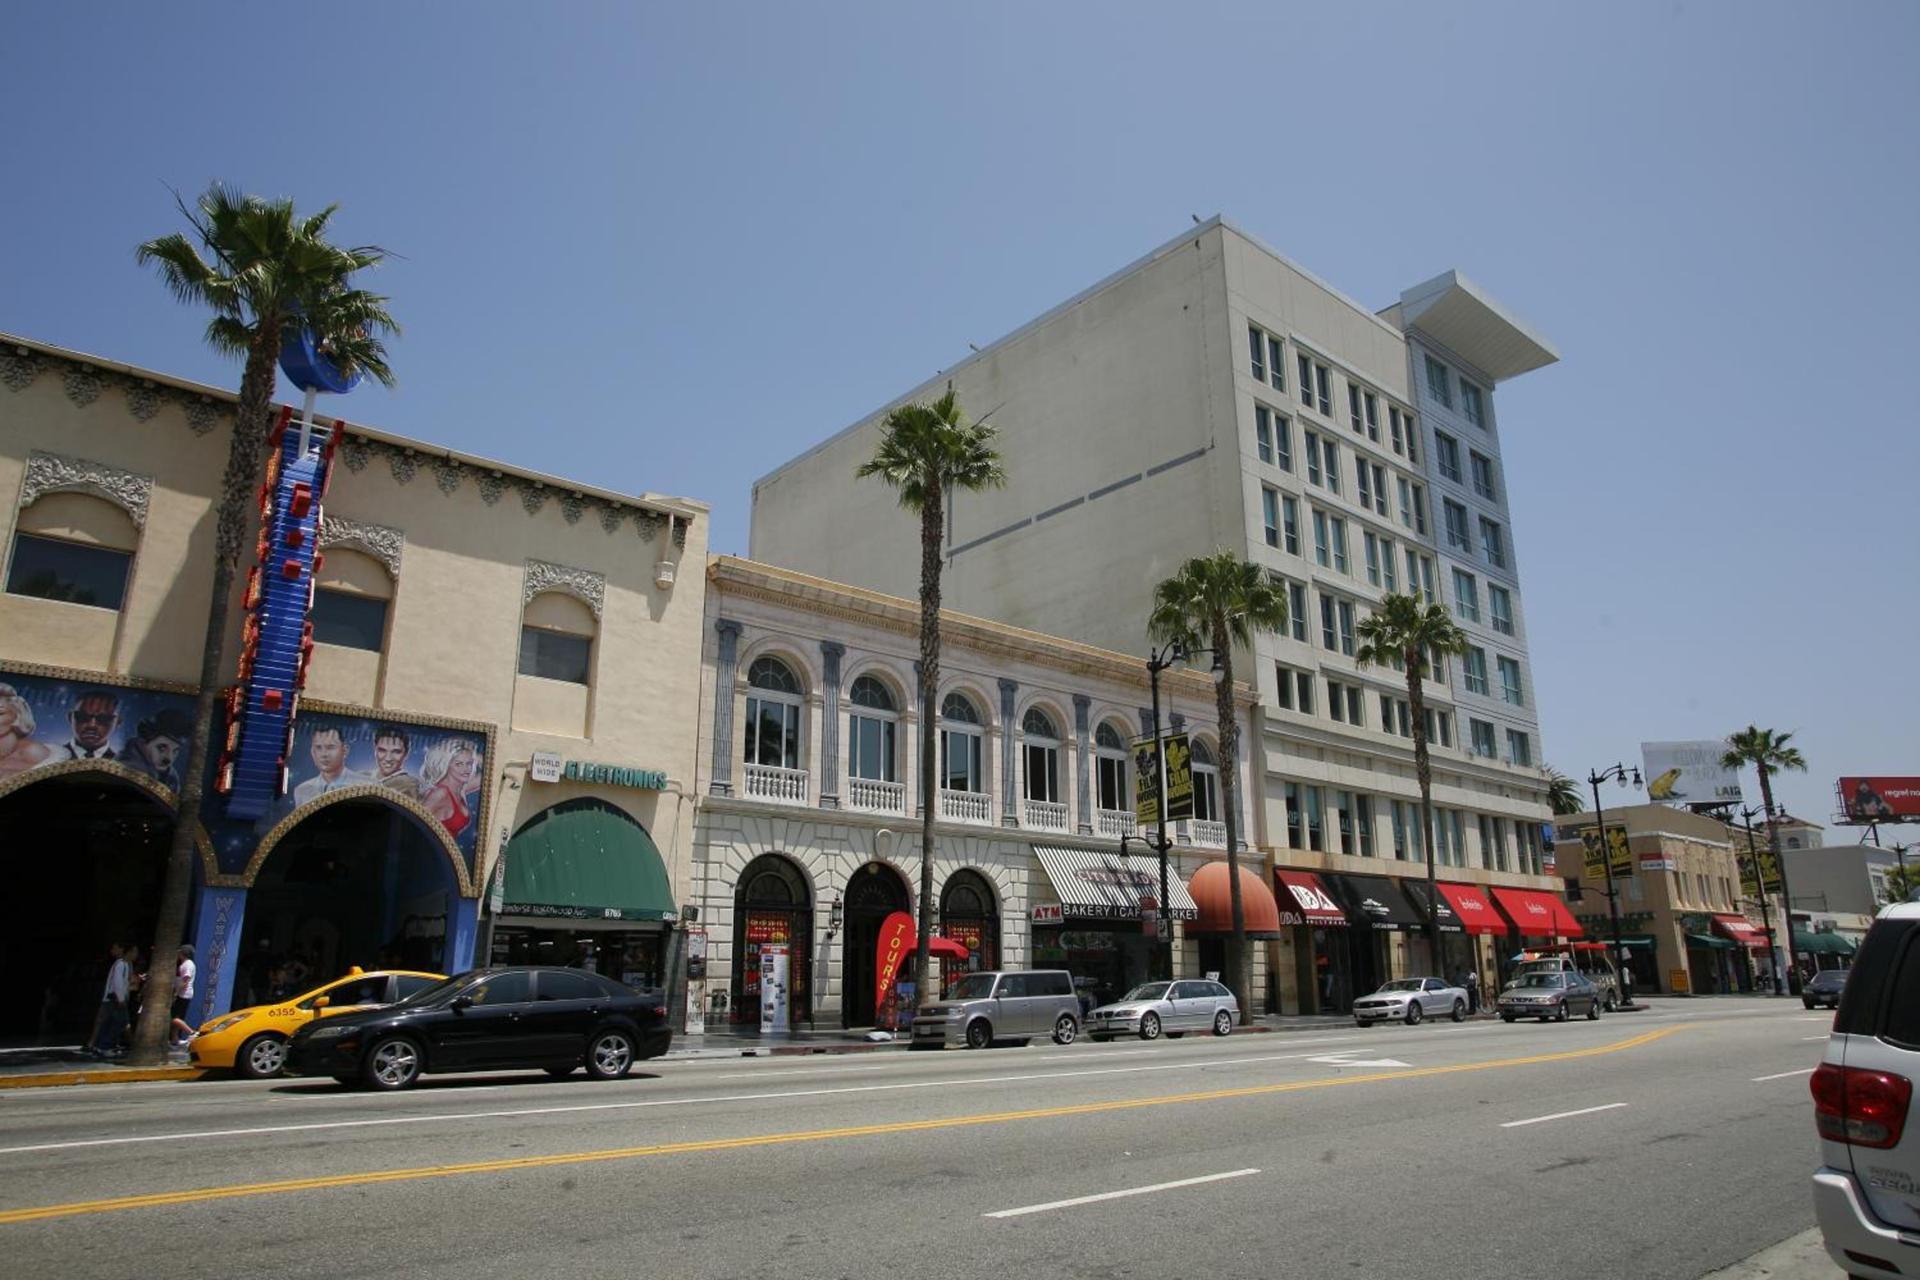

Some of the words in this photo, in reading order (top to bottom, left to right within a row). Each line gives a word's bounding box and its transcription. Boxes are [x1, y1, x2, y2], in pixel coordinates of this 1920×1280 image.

[534, 759, 561, 768] WORLD
[536, 767, 556, 777] WIDE
[565, 760, 667, 791] ELECTRONICS
[1884, 788, 1909, 798] regret
[1034, 908, 1061, 919] ATM
[1063, 905, 1111, 917] BAKERY
[1119, 909, 1142, 918] CAF
[880, 923, 906, 991] TOURS
[203, 939, 226, 1020] MUSEU
